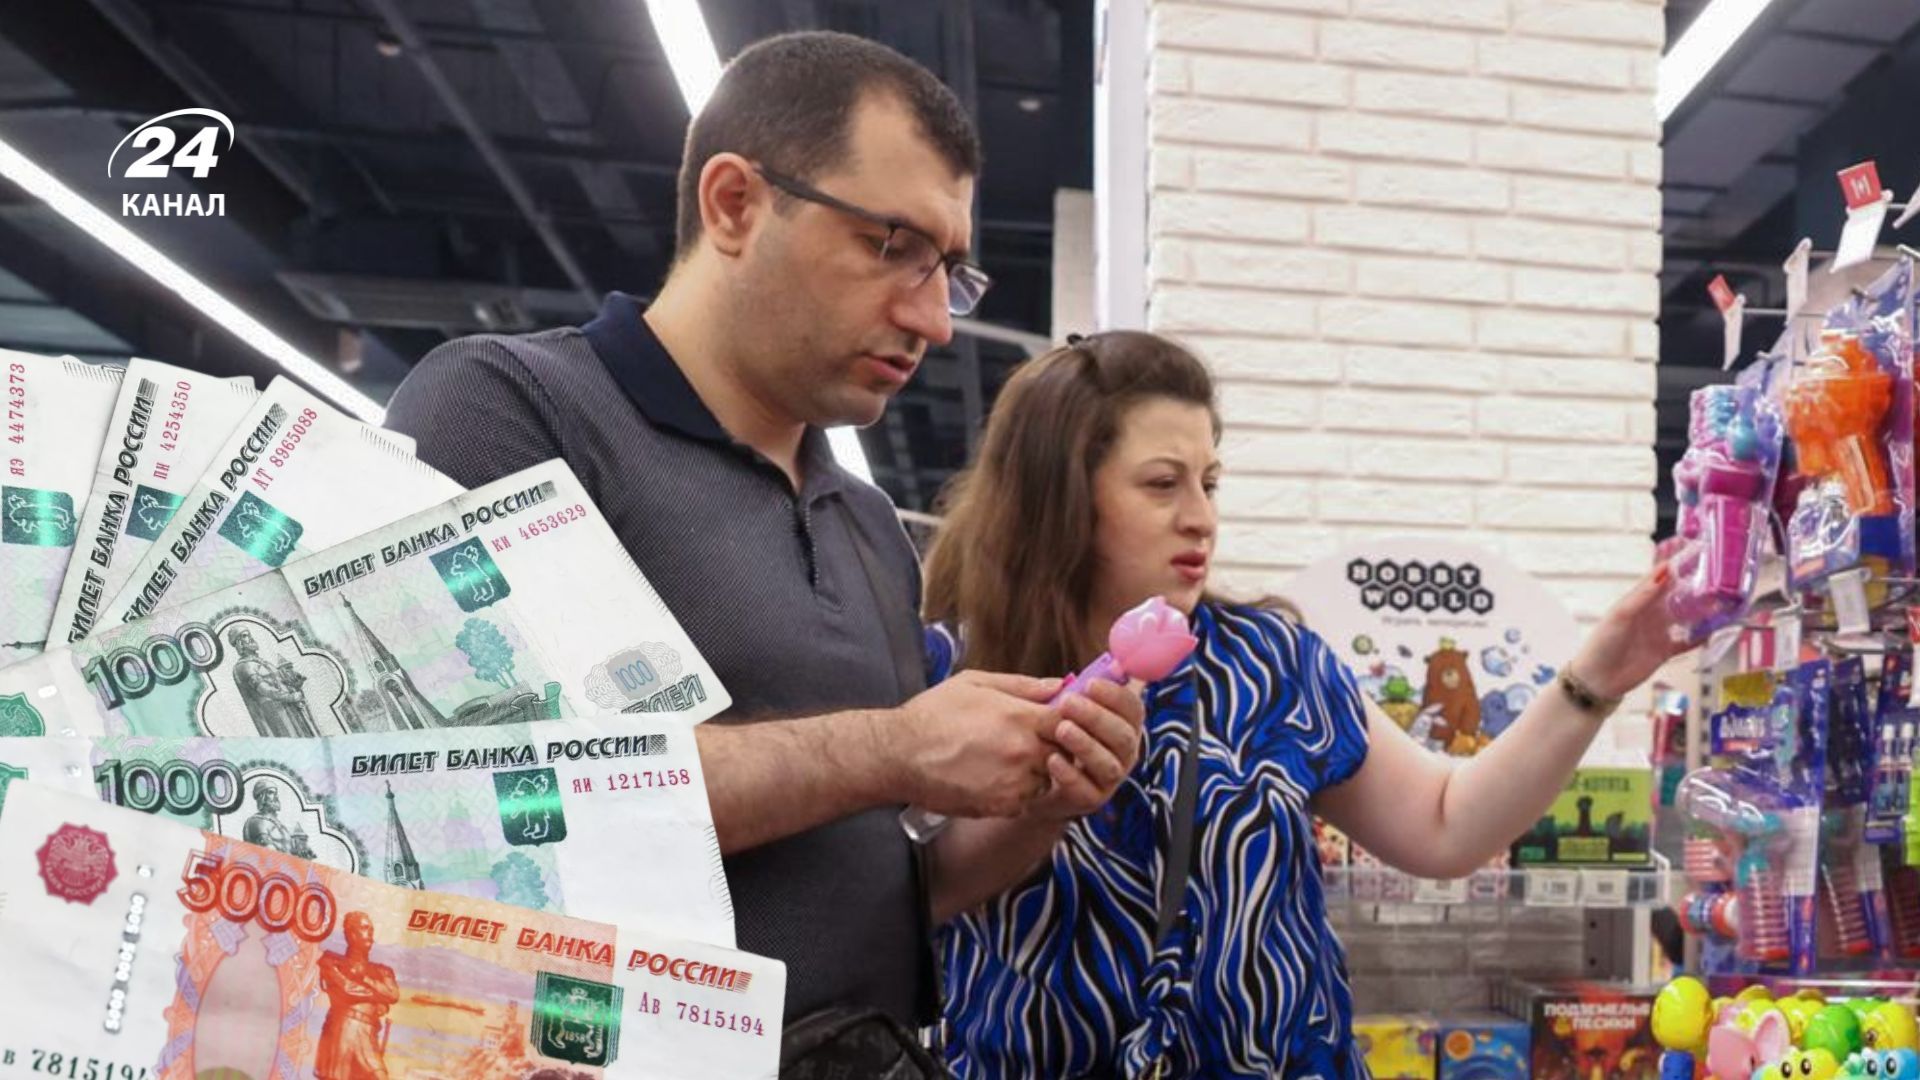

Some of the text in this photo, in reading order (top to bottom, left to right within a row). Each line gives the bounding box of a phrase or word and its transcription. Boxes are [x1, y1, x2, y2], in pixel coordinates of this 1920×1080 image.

[8, 363, 25, 444] 4474373
[160, 381, 192, 452] 4254350
[90, 490, 129, 568] БАНКА
[113, 394, 156, 487] РОССИИ
[251, 407, 319, 491] АТ 8965088
[170, 489, 227, 565] БАНКА
[220, 411, 280, 491] РОССИИ
[518, 503, 588, 542] 4653629
[303, 484, 547, 598] БИЛЕТ БАНКА РОССИИ
[1349, 558, 1481, 587] HOBBY
[1361, 583, 1494, 615] WORLD
[81, 622, 225, 711] 1000
[615, 660, 655, 692] 1000
[94, 759, 245, 815] 1000
[351, 735, 652, 777] БИЛЕТ БАНКА РОССИИ
[607, 769, 691, 792] 1217158
[176, 849, 337, 943] 5000
[407, 909, 739, 990] БИЛЕТ БАНКА РОССИИ
[677, 1002, 765, 1036] 7815194
